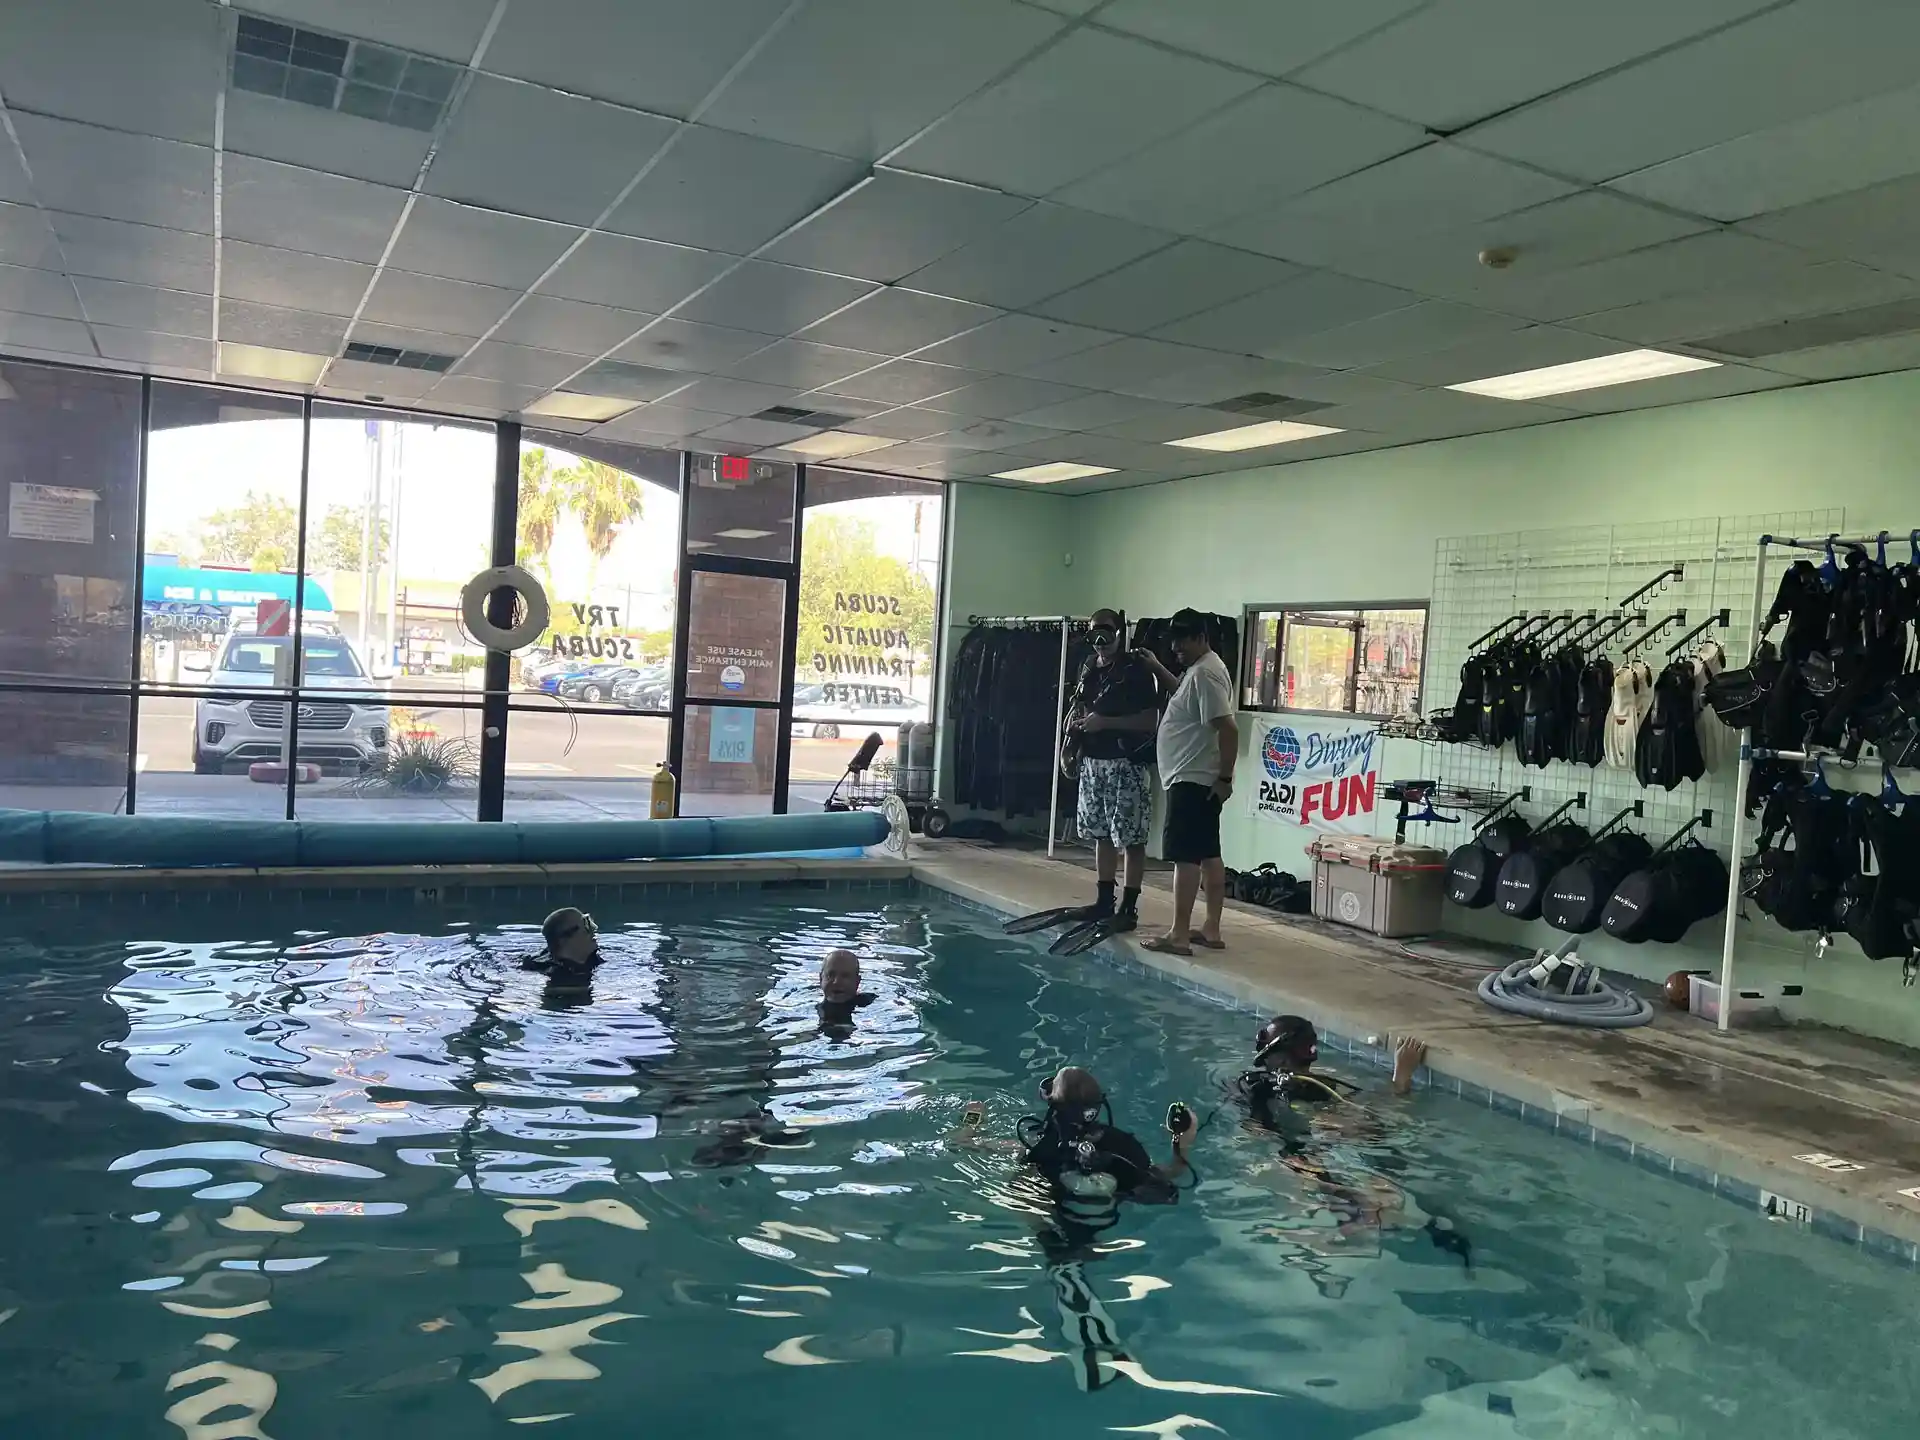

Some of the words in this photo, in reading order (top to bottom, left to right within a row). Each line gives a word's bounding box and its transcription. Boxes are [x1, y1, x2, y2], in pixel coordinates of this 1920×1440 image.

[722, 456, 749, 480] EXIT
[1305, 727, 1376, 775] Diving
[1259, 780, 1297, 806] PADI
[1300, 770, 1377, 825] FUN
[1258, 801, 1295, 816] padi.com
